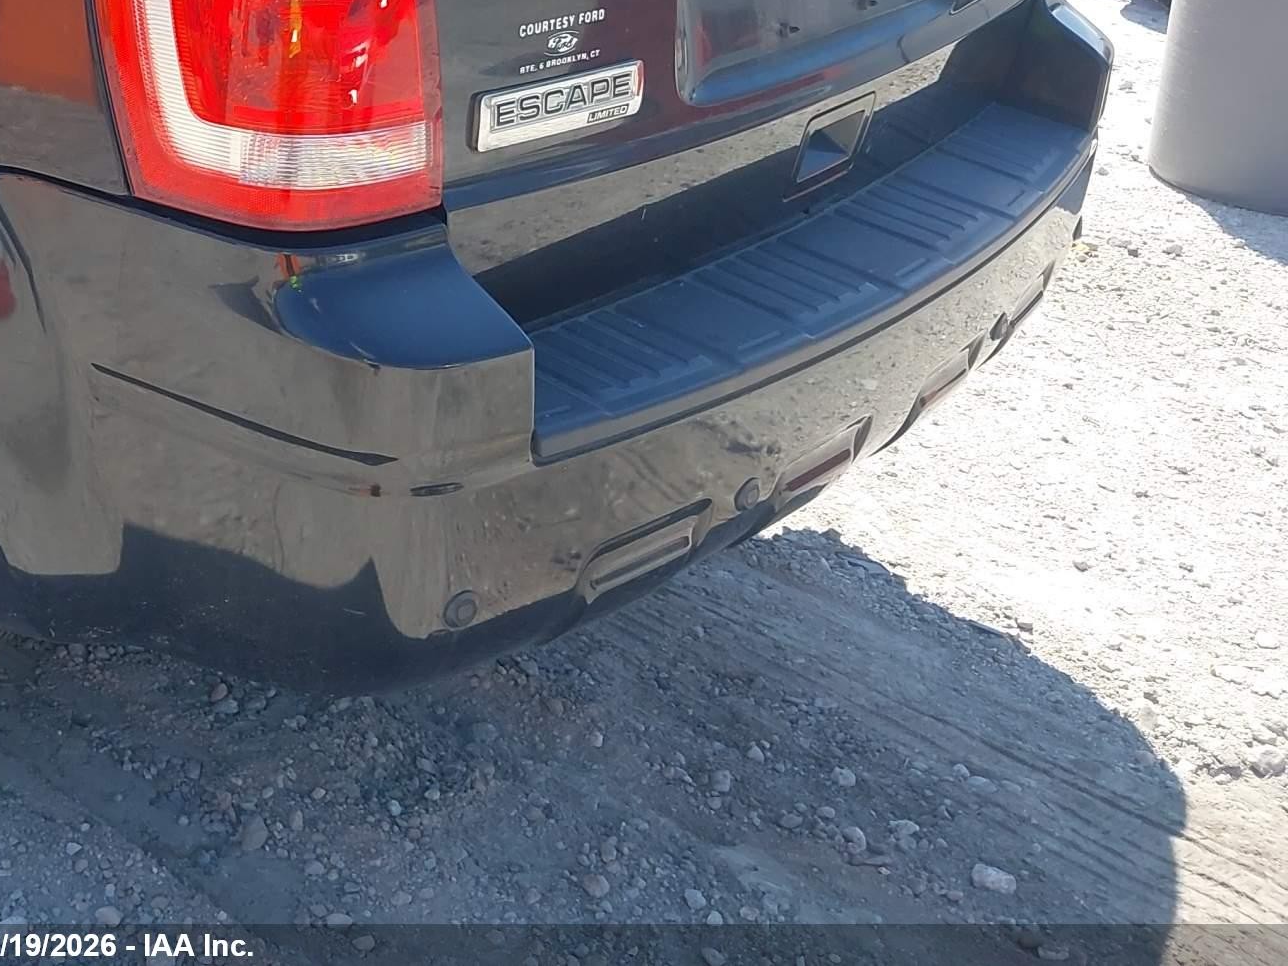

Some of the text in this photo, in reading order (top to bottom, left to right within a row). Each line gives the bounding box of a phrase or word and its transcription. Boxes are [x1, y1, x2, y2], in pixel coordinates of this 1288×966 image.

[519, 9, 605, 37] COURTESY FORD
[496, 72, 632, 127] ESCAPE
[588, 105, 628, 123] LIMITED
